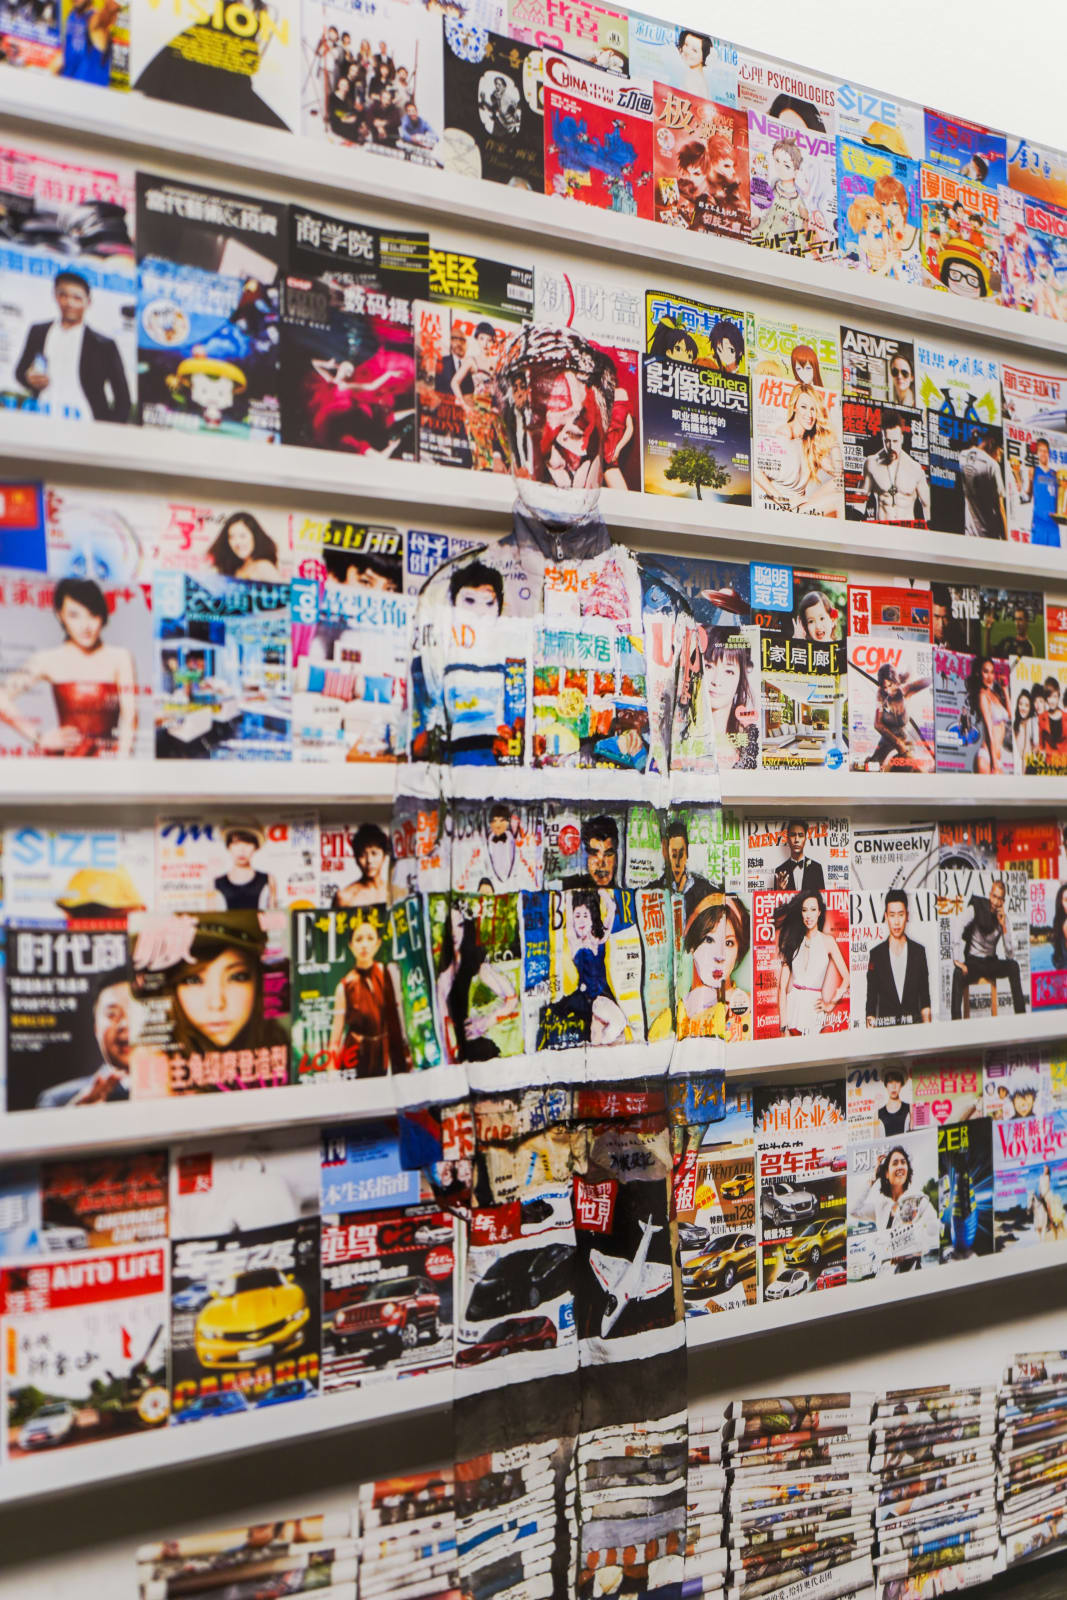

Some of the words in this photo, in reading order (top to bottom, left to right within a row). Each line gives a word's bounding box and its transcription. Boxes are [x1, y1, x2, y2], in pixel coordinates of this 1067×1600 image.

[545, 57, 588, 92] CHINA
[767, 70, 835, 107] PSYCHOLOGIES
[748, 110, 836, 157] Newtype
[921, 167, 1000, 223] 漫画世界
[294, 213, 375, 260] 商学院
[646, 361, 748, 412] 影像视觉
[700, 371, 748, 392] Camera
[1004, 369, 1061, 400] 航空知识
[1009, 426, 1032, 443] NBA
[754, 566, 788, 588] 聪明
[755, 614, 771, 627] 07
[853, 591, 870, 634] 环球
[951, 601, 981, 619] STYLE
[762, 638, 839, 673] ELLE
[769, 645, 829, 667] 家居廊
[748, 829, 788, 849] MEN'S
[807, 823, 829, 840] YLE
[829, 818, 849, 832] 时尚
[829, 833, 850, 847] 芭莎
[854, 836, 931, 853] CBNweekly
[747, 858, 764, 868] 陈坤
[829, 848, 849, 858] 男士
[854, 853, 903, 864] 第一财经周刊
[936, 894, 963, 916] 艺术
[1007, 898, 1027, 913] ART
[1030, 882, 1047, 925] 時尚
[755, 893, 776, 942] 時尚
[757, 1013, 766, 1028] 16
[297, 1045, 360, 1073] LOVE
[762, 1103, 845, 1132] 中国企业家
[760, 1147, 825, 1177] 名车志
[734, 1203, 754, 1222] 128
[53, 1260, 113, 1290] AUTO
[118, 1253, 162, 1281] LIFE
